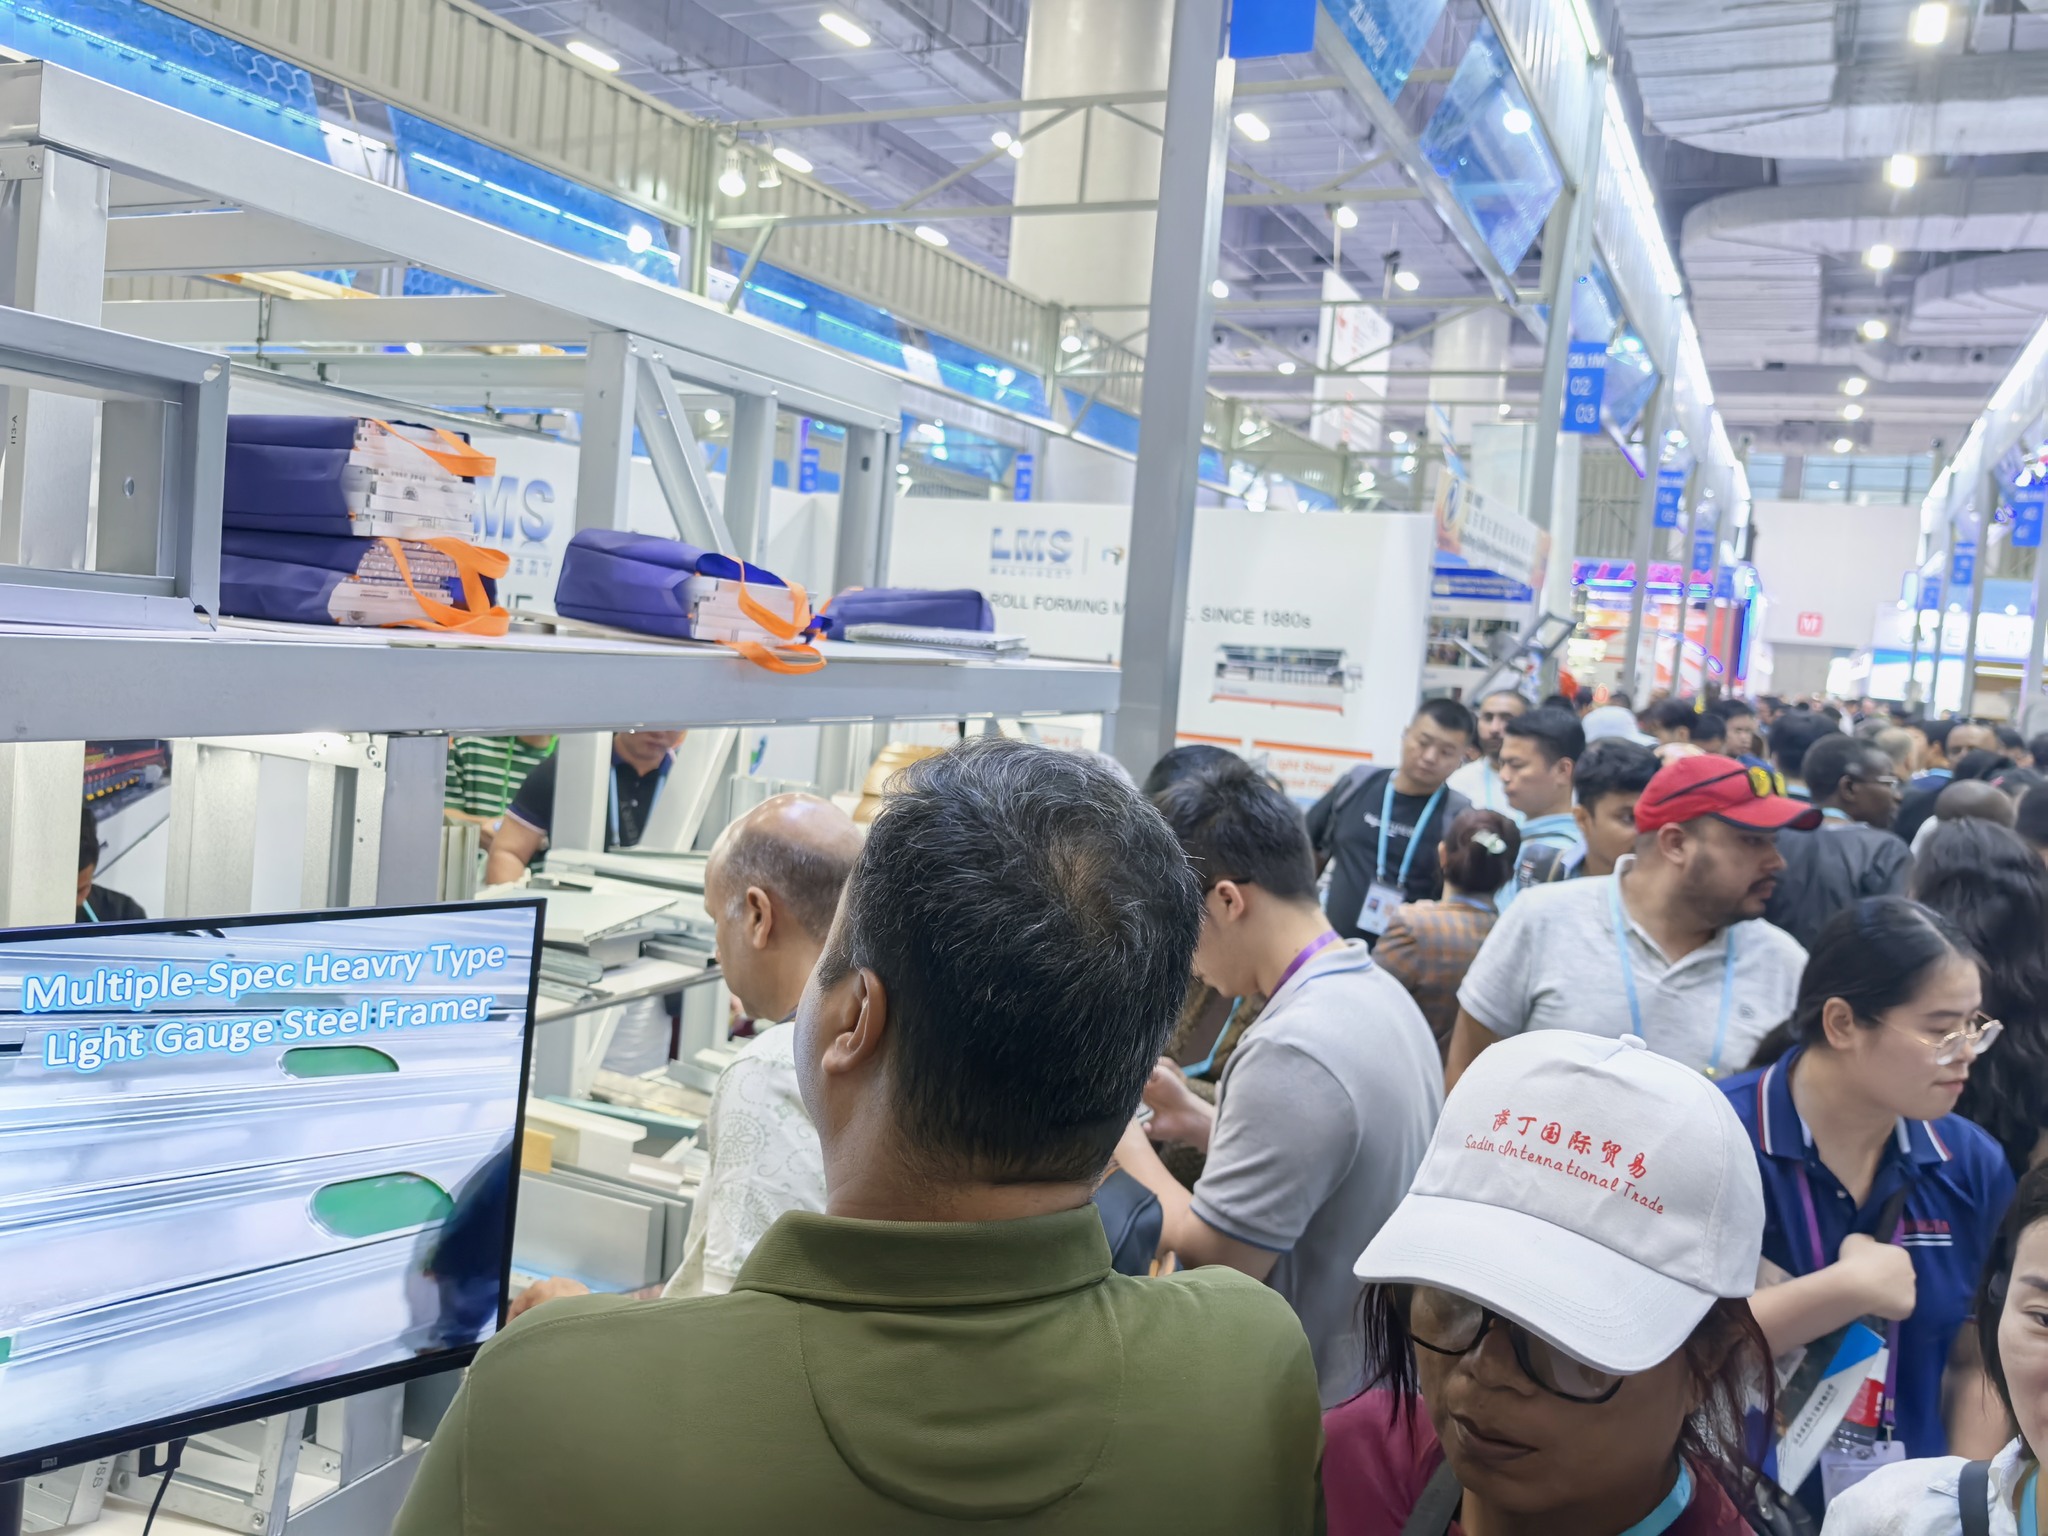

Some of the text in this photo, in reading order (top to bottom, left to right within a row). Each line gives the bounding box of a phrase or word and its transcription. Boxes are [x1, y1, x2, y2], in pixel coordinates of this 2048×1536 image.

[1570, 376, 1591, 396] 02
[473, 475, 555, 542] MS
[991, 527, 1074, 563] LMS
[991, 593, 1029, 610] ROLL
[1033, 596, 1109, 616] FORMING
[1201, 607, 1255, 625] SINCE
[26, 943, 506, 1010] Multiple-Spec Heavry Type
[47, 995, 493, 1069] Light Gauge Steel Framer
[1465, 1134, 1664, 1214] Sadin International Trade
[1493, 1108, 1647, 1179] 萨丁国际贸易
